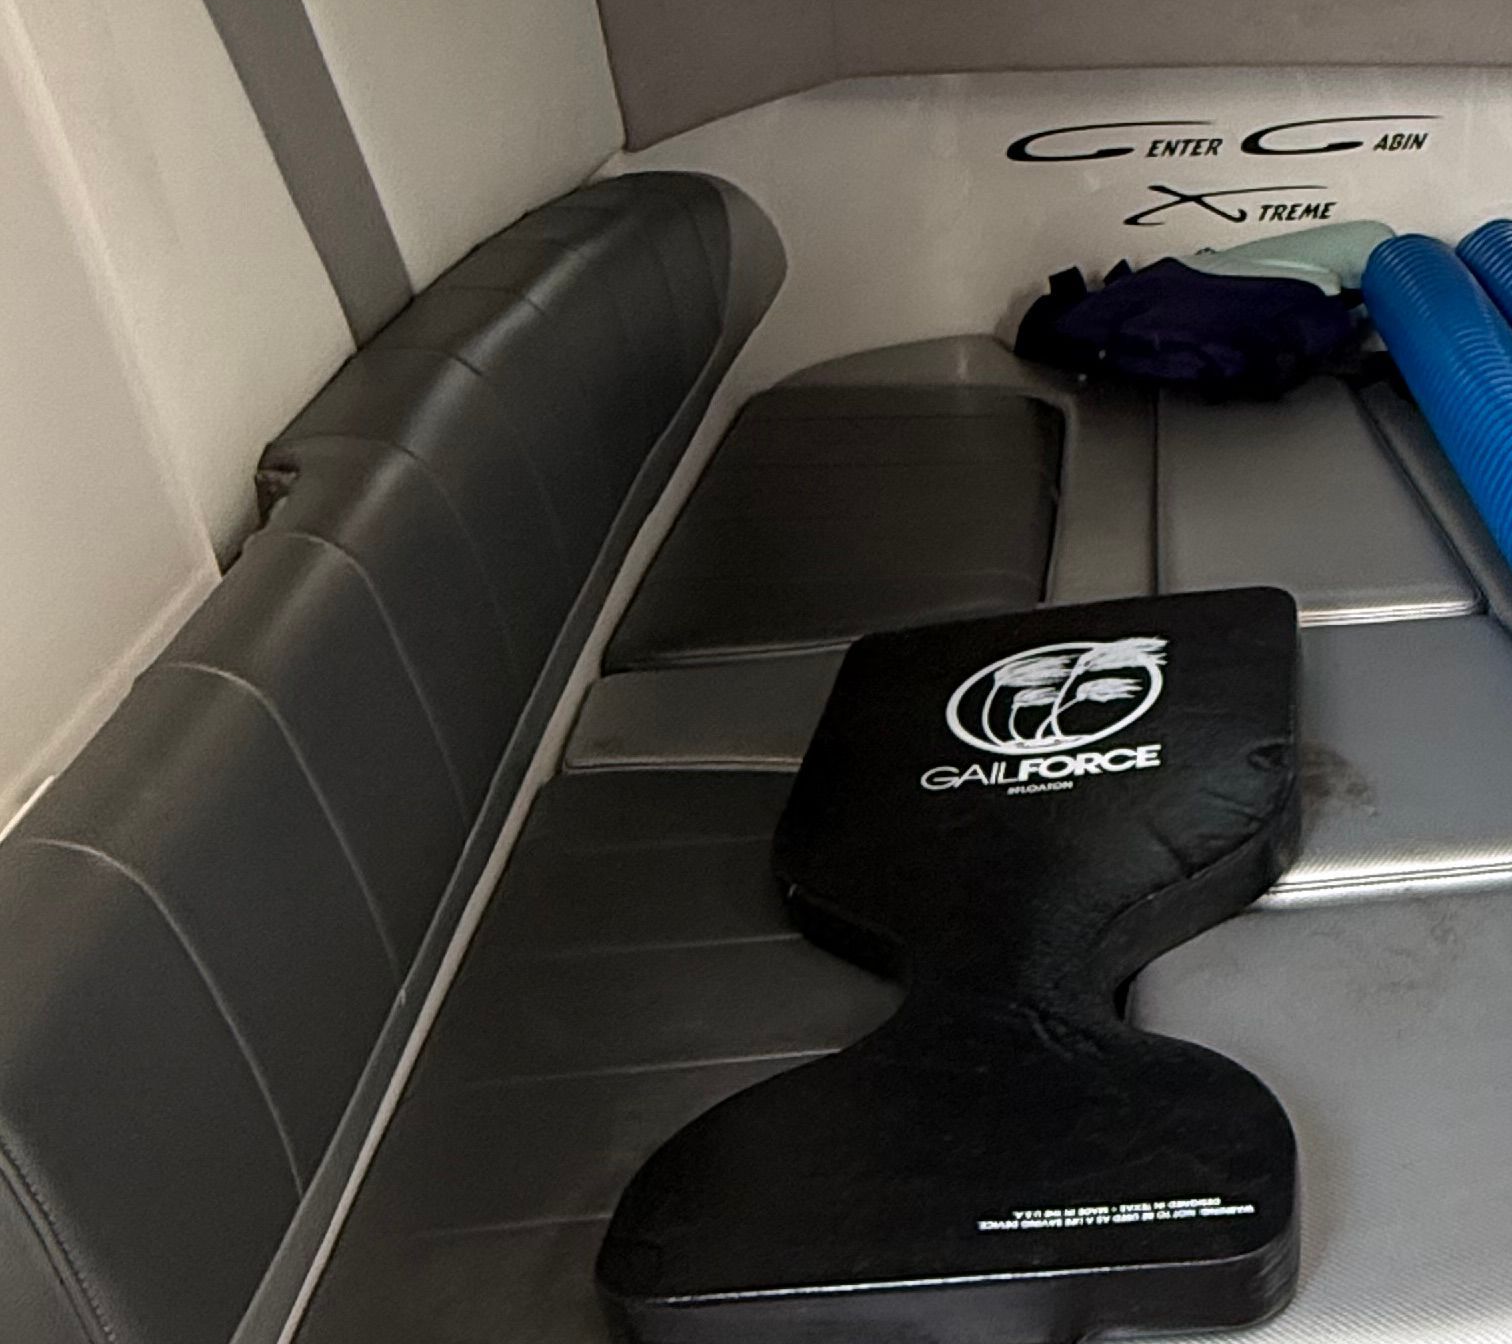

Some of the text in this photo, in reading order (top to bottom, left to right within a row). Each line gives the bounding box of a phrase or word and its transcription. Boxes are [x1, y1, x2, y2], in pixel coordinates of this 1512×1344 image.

[1006, 114, 1441, 162] CENTER CABIN
[1123, 184, 1336, 226] XTREME
[920, 744, 1162, 791] GAILFORCE
